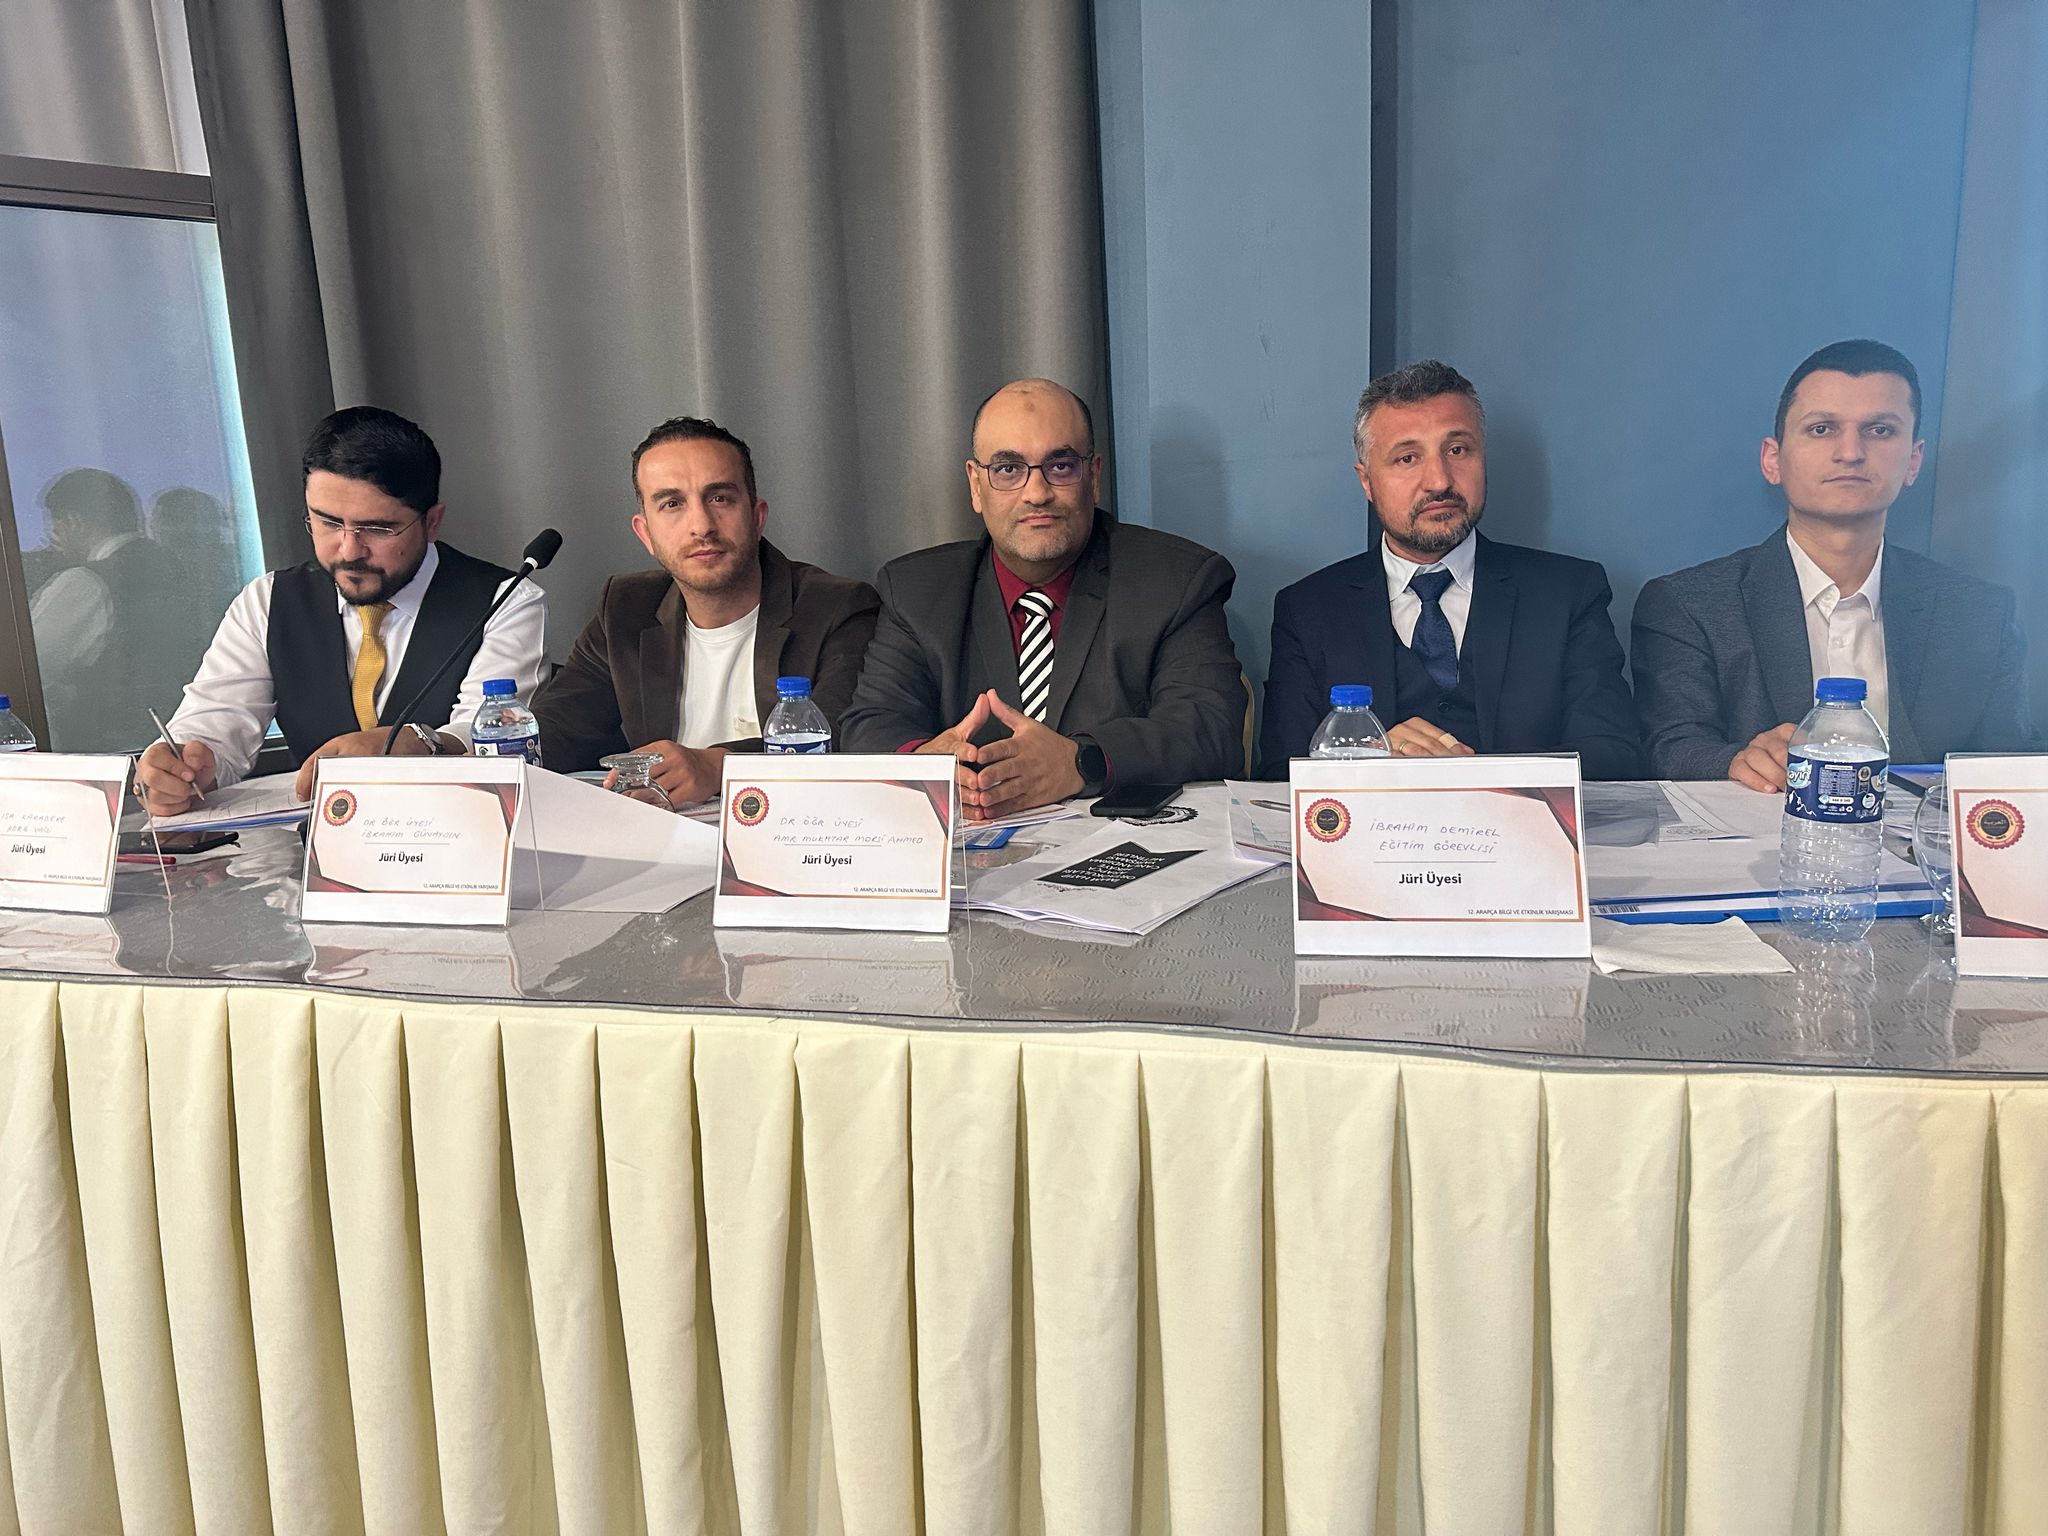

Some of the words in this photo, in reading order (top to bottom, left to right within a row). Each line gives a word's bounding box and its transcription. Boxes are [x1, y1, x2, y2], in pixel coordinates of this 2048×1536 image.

[780, 817, 796, 826] DR
[1370, 818, 1428, 833] İBRAHİM
[1440, 826, 1501, 838] DEMİREL
[773, 834, 797, 843] AMR
[11, 844, 25, 854] Jüri
[26, 843, 46, 856] Üyesi
[378, 852, 396, 862] Jüri
[398, 850, 424, 864] Üyesi
[802, 854, 822, 864] Jüri
[824, 853, 852, 867] Üyesi
[1398, 872, 1422, 884] Jüri
[1426, 871, 1462, 886] Üyesi
